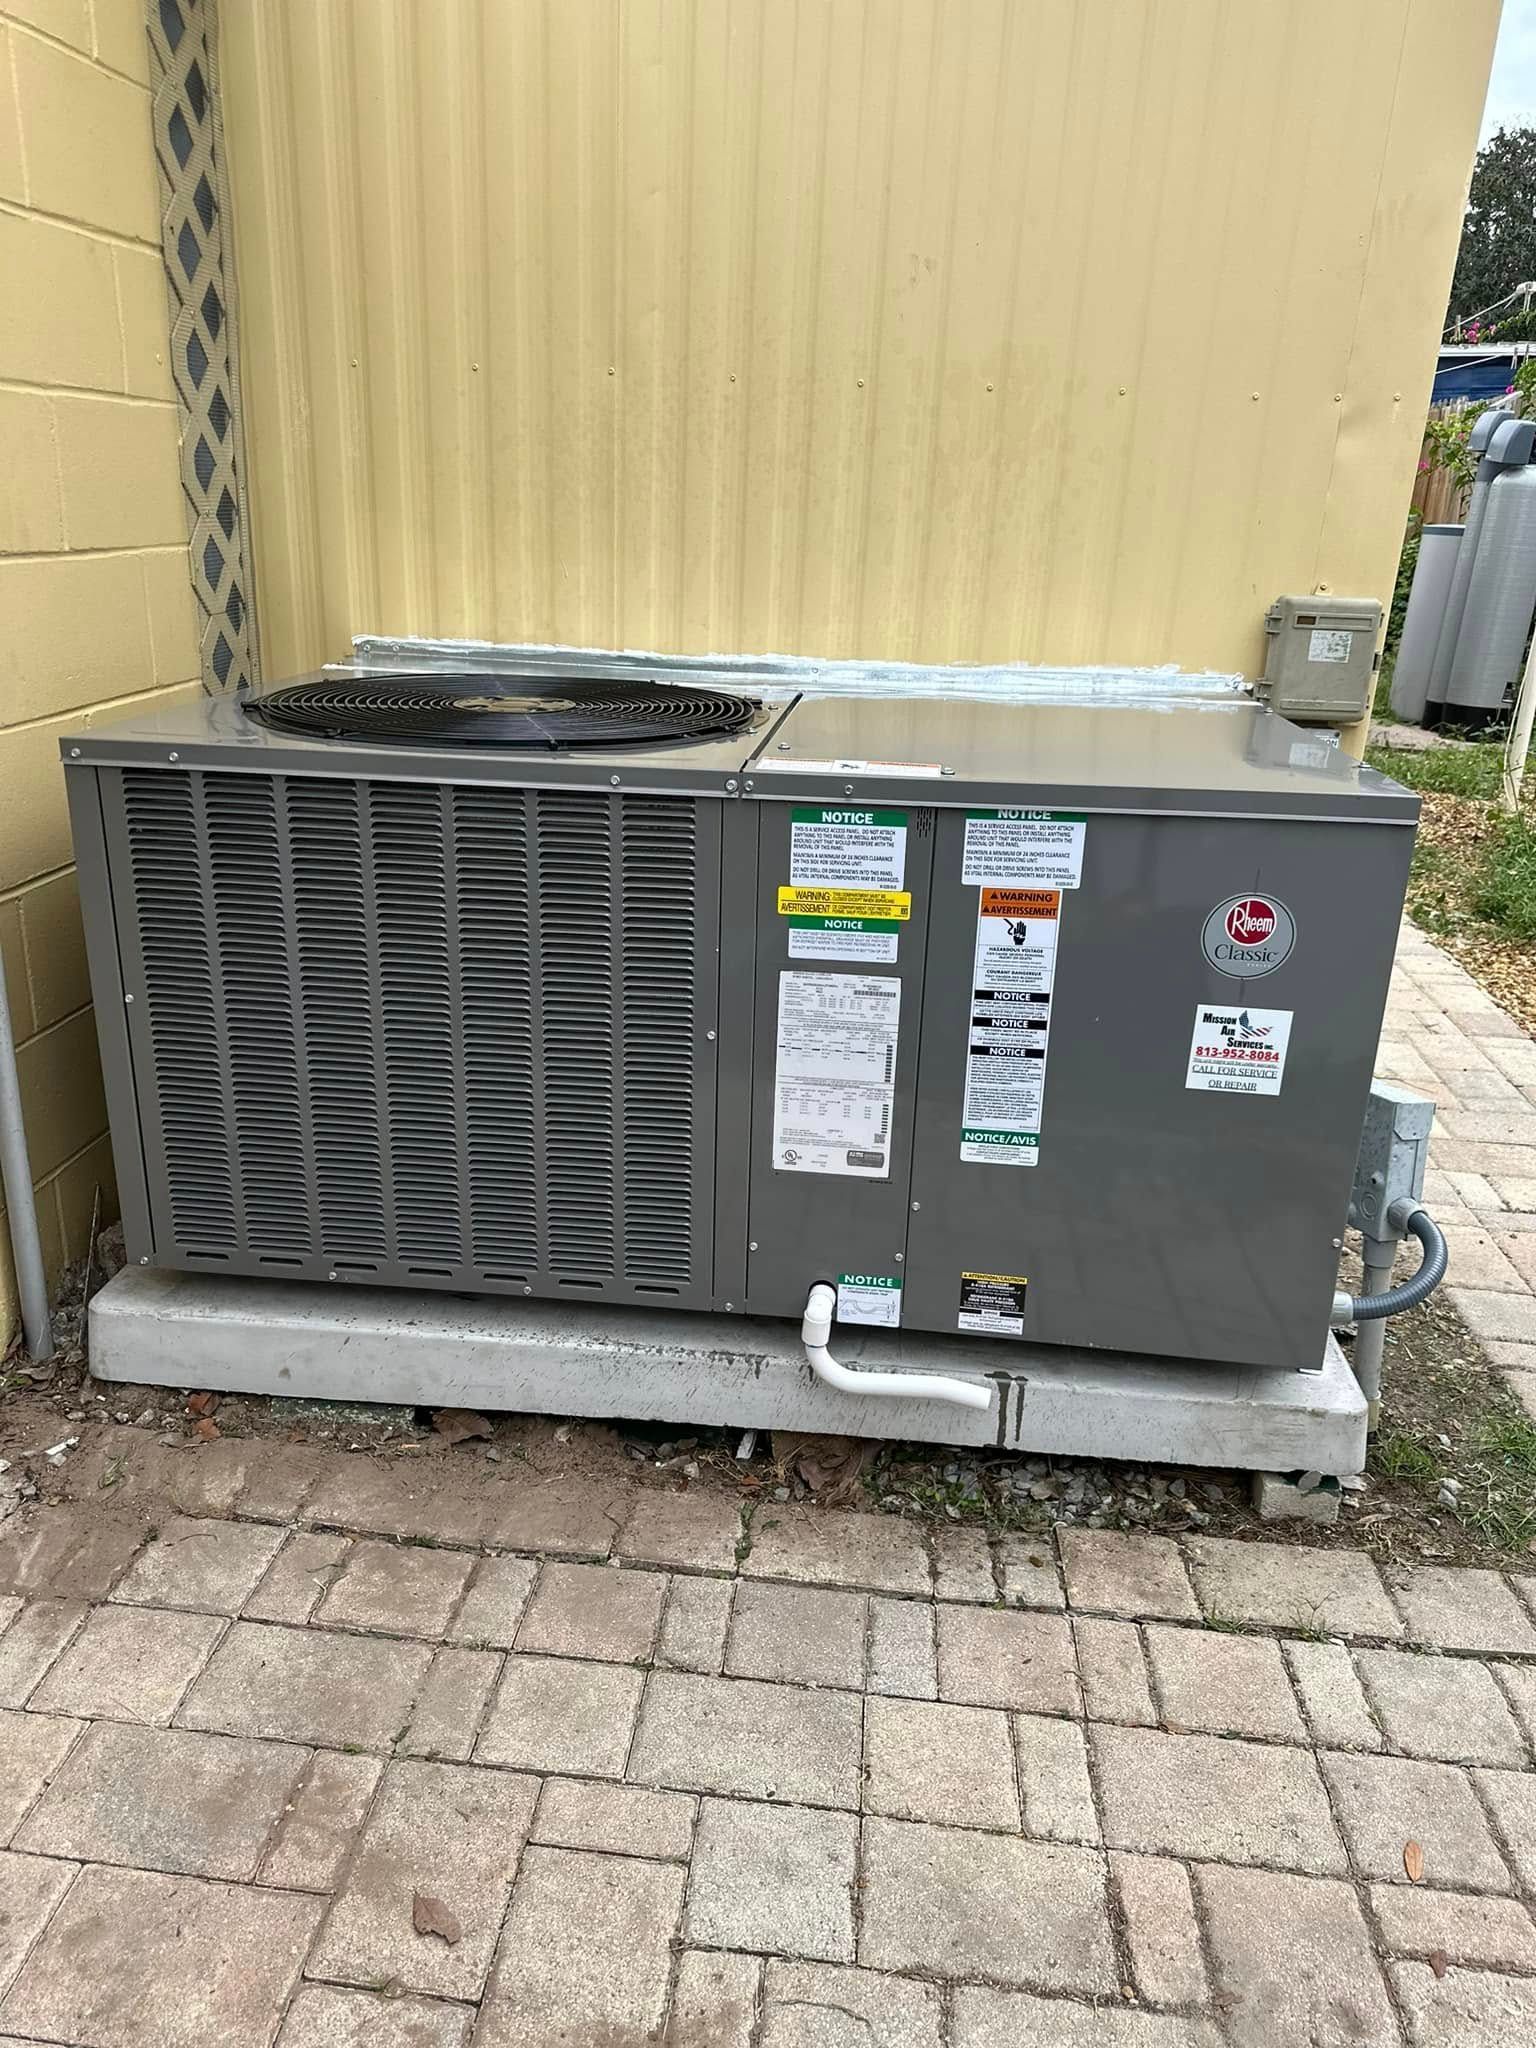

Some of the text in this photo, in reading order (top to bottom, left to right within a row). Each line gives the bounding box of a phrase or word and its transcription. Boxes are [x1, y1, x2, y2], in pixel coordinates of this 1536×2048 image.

[822, 812, 873, 824] NOTICE
[997, 809, 1052, 820] NOTICE
[1000, 892, 1052, 902] WARNING
[781, 903, 830, 913] AVERTISSEMENT
[991, 906, 1056, 916] AVERTISSEMENT
[825, 919, 863, 930] NOTICE
[1232, 901, 1273, 937] Rheem
[1214, 944, 1278, 962] Classic
[994, 992, 1031, 1001] NOTICE
[992, 1019, 1029, 1028] NOTICE
[990, 1048, 1026, 1056] NOTICE
[1195, 1046, 1279, 1061] 813-952-8084
[1192, 1064, 1277, 1078] CALL FOR SERVICE
[1208, 1080, 1257, 1090] OR REPAIR
[965, 1132, 1036, 1145] NOTICE/AVIS
[844, 1275, 893, 1286] NOTICE
